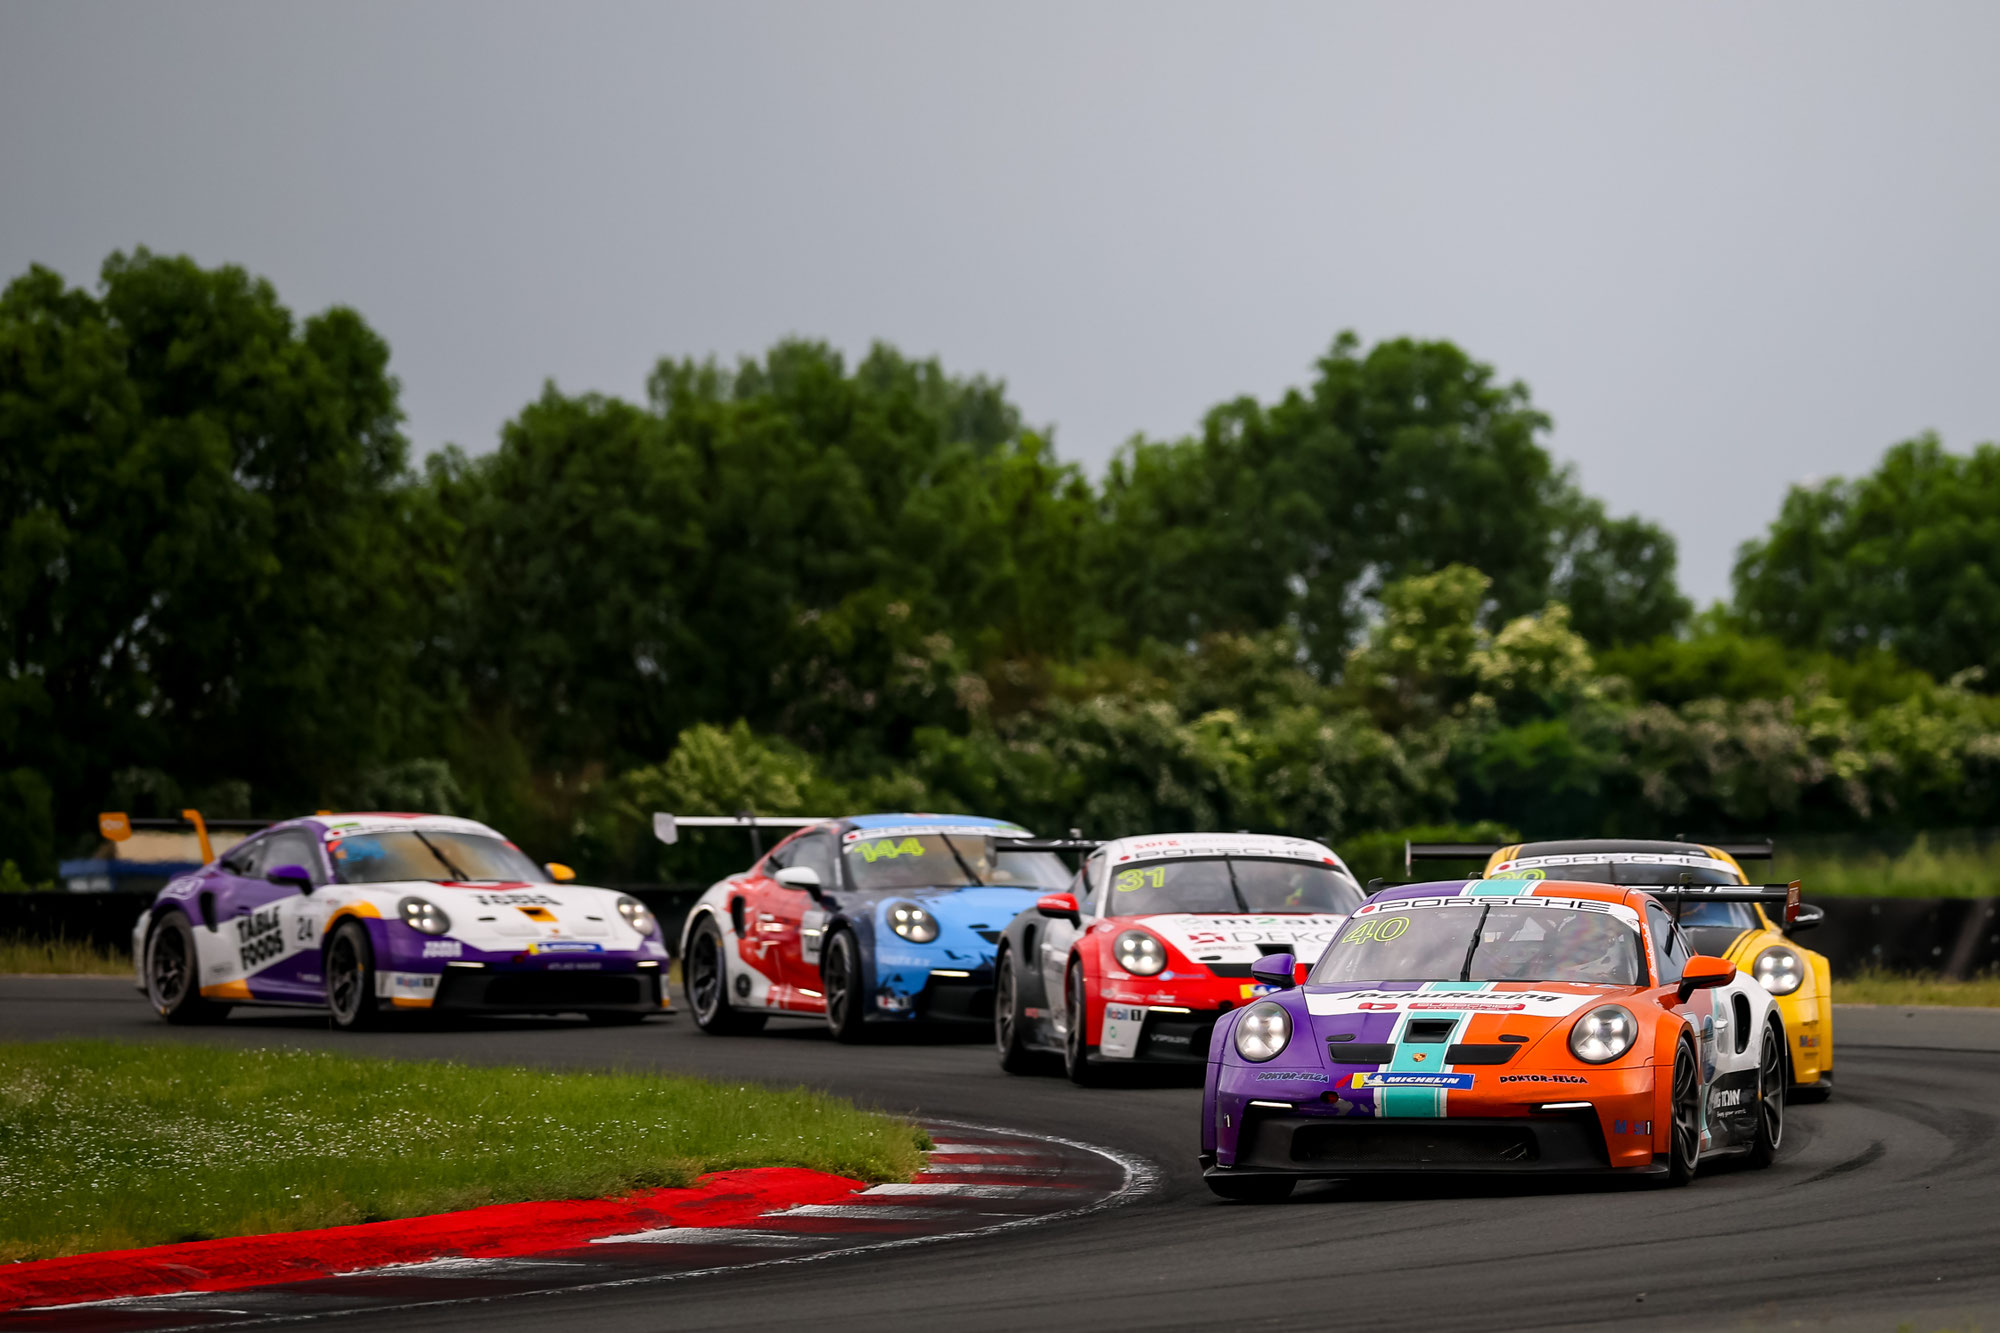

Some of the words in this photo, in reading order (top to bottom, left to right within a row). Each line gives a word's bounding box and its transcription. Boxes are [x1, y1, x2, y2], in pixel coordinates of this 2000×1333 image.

[854, 837, 926, 863] 144
[1135, 847, 1318, 859] PORSCHE
[1516, 854, 1713, 867] PORSCHE
[1116, 867, 1165, 892] 31
[1378, 897, 1611, 912] PORSCHE
[236, 906, 281, 943] TABLE
[297, 917, 313, 941] 24
[1342, 917, 1410, 945] 40
[240, 930, 285, 971] FOODS
[1256, 1072, 1329, 1083] DOKTOR-FELGA
[1386, 1076, 1460, 1085] MICHELIN
[1500, 1074, 1589, 1084] DOKTOR-FELGA
